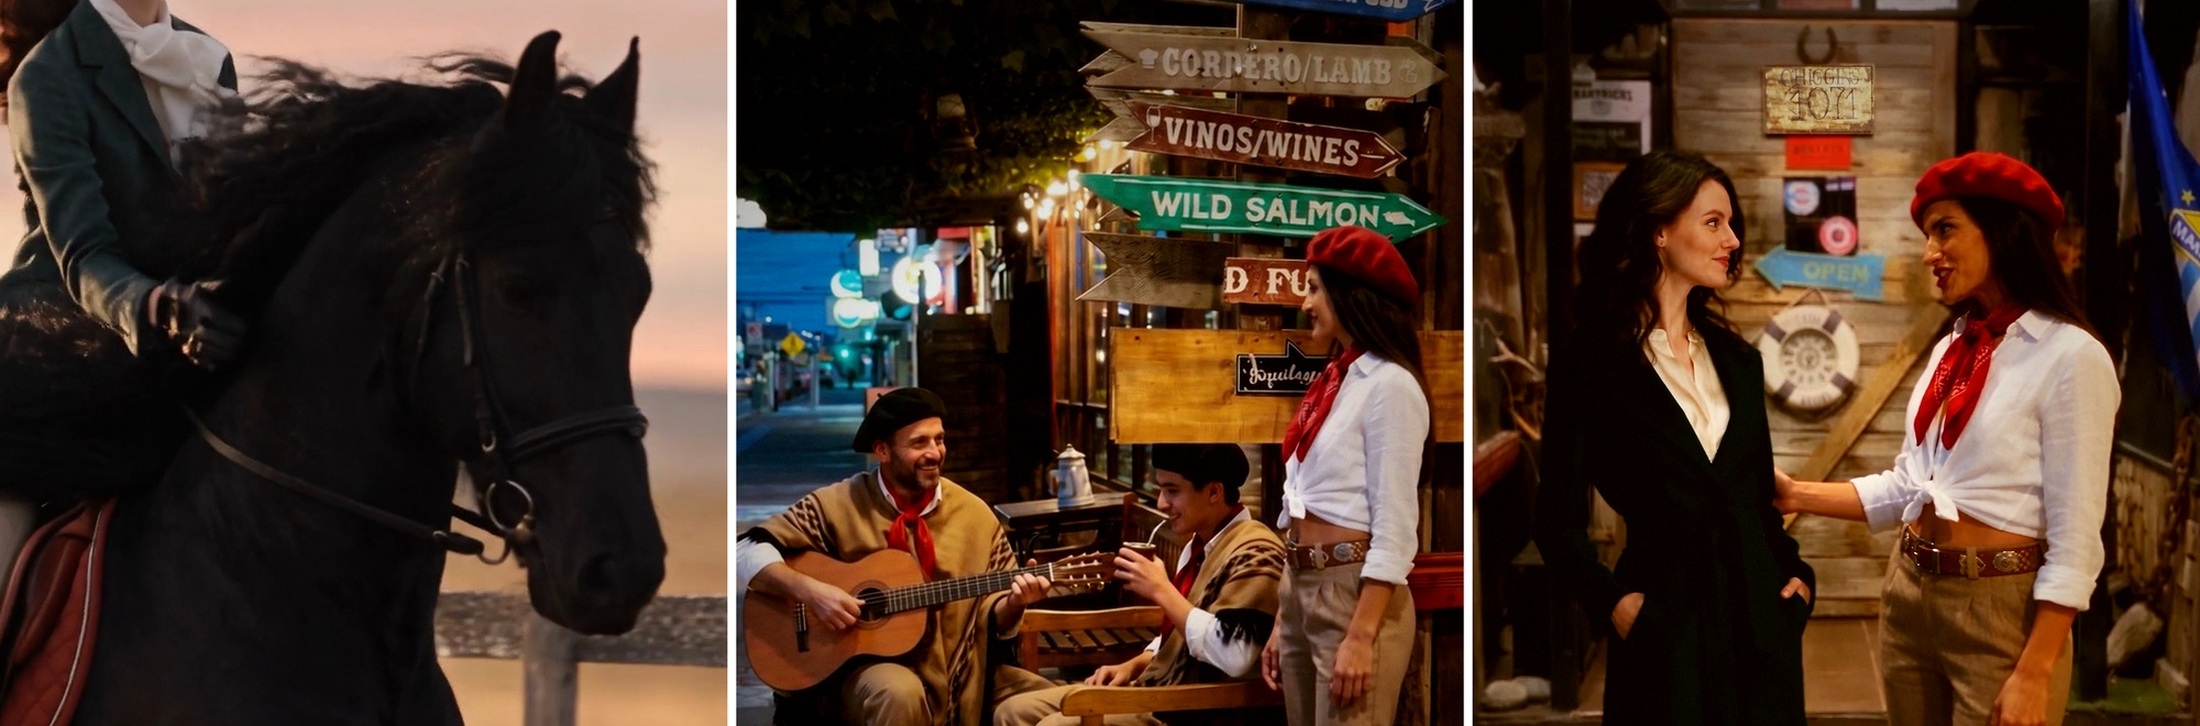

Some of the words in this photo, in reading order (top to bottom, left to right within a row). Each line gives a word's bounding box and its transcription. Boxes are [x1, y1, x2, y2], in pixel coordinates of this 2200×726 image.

[1162, 47, 1392, 85] CORDERO/LAMB
[1164, 116, 1360, 166] VINOS/WINES
[1151, 190, 1232, 221] WILD
[1245, 196, 1380, 228] SALMON
[1803, 261, 1869, 285] OPEN
